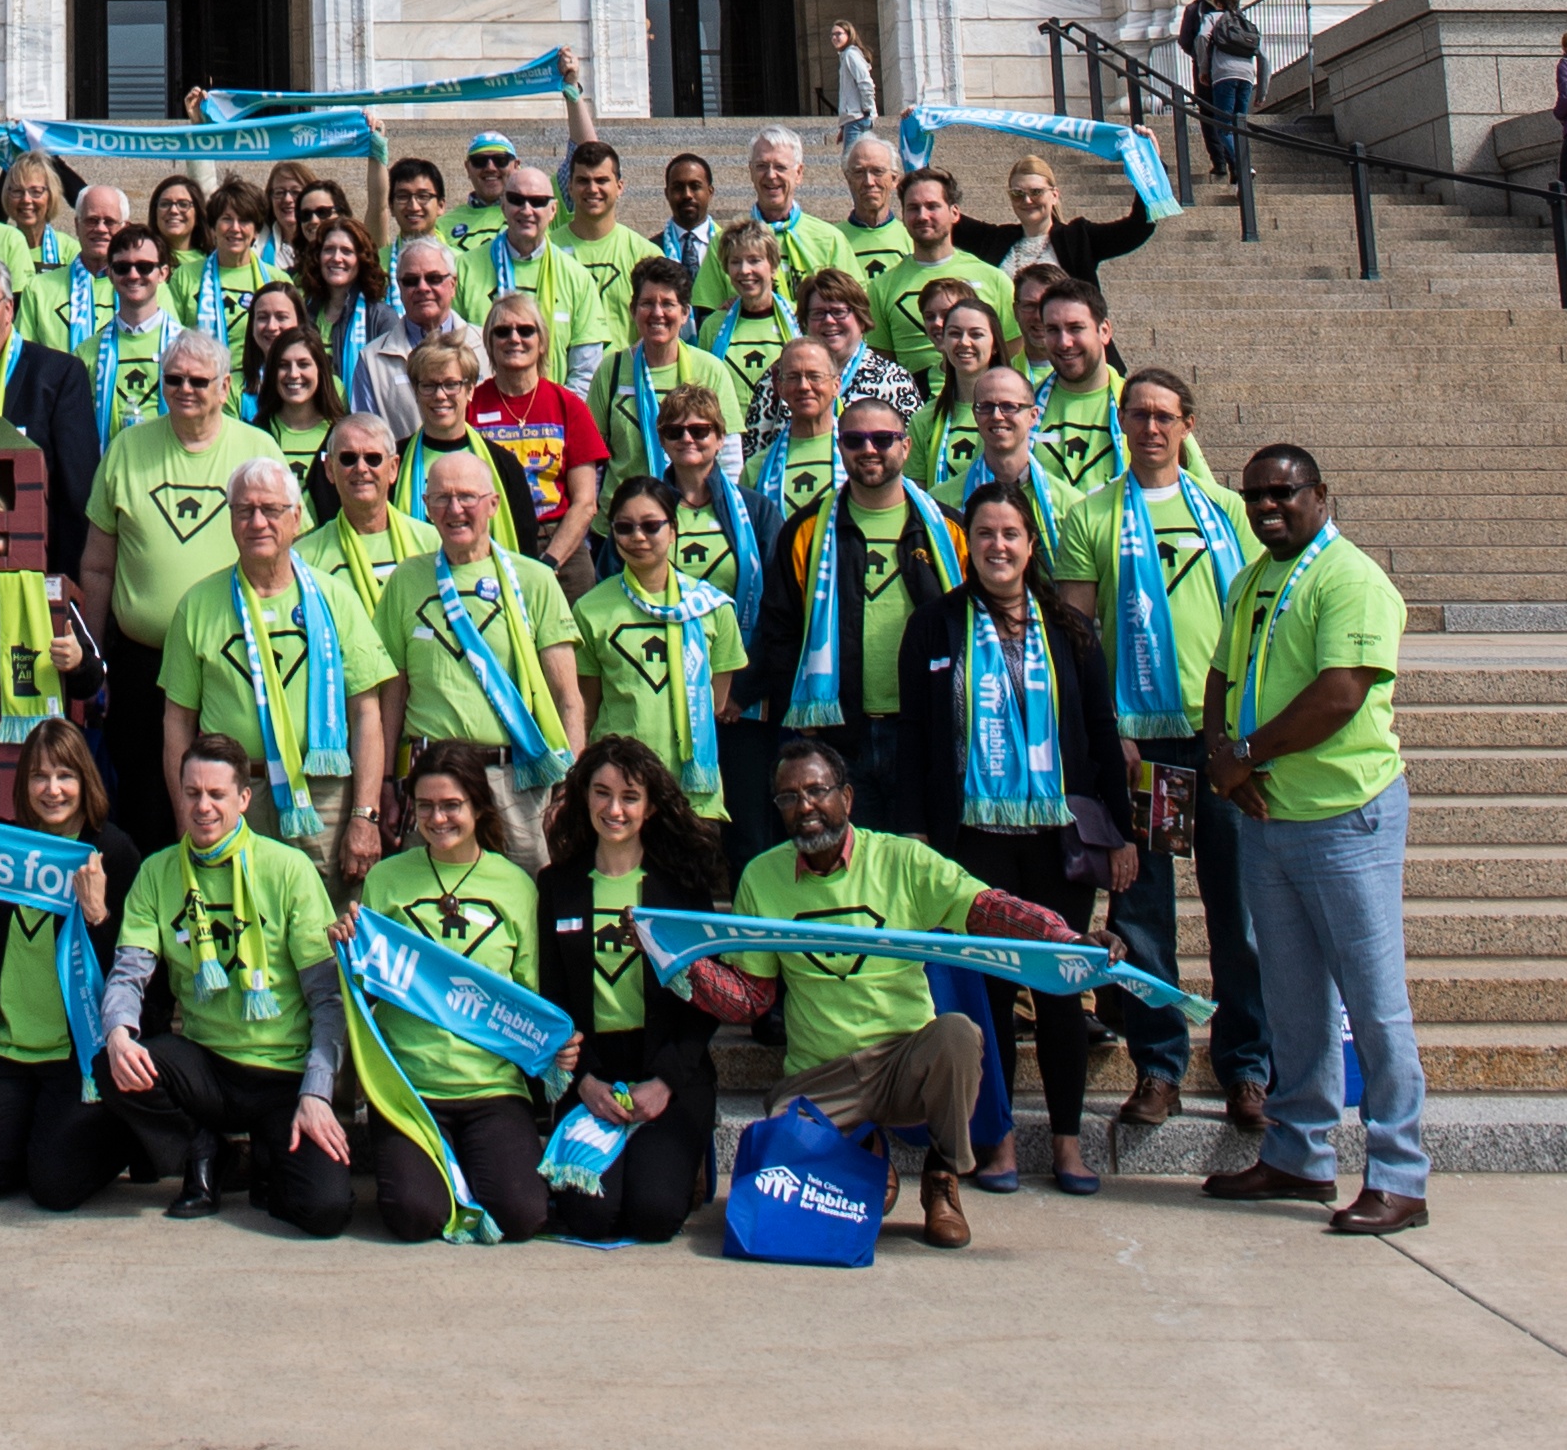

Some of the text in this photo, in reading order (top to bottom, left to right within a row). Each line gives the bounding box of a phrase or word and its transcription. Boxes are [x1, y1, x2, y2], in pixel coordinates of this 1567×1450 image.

[77, 127, 271, 151] Homes for All
[1053, 118, 1098, 143] All
[497, 428, 520, 439] Can
[522, 427, 539, 437] Do
[1347, 632, 1382, 641] HOUSING
[1354, 639, 1375, 647] HERO
[18, 670, 32, 681] All
[1134, 632, 1154, 693] Habitat
[989, 718, 1006, 777] Habitat
[24, 849, 77, 899] for
[361, 932, 420, 992] All
[486, 1017, 542, 1057] for Humanity
[489, 1001, 549, 1048] Habitat
[807, 1172, 844, 1195] Twin Cities
[799, 1198, 864, 1224] for Humanity
[801, 1183, 867, 1215] Habitat
